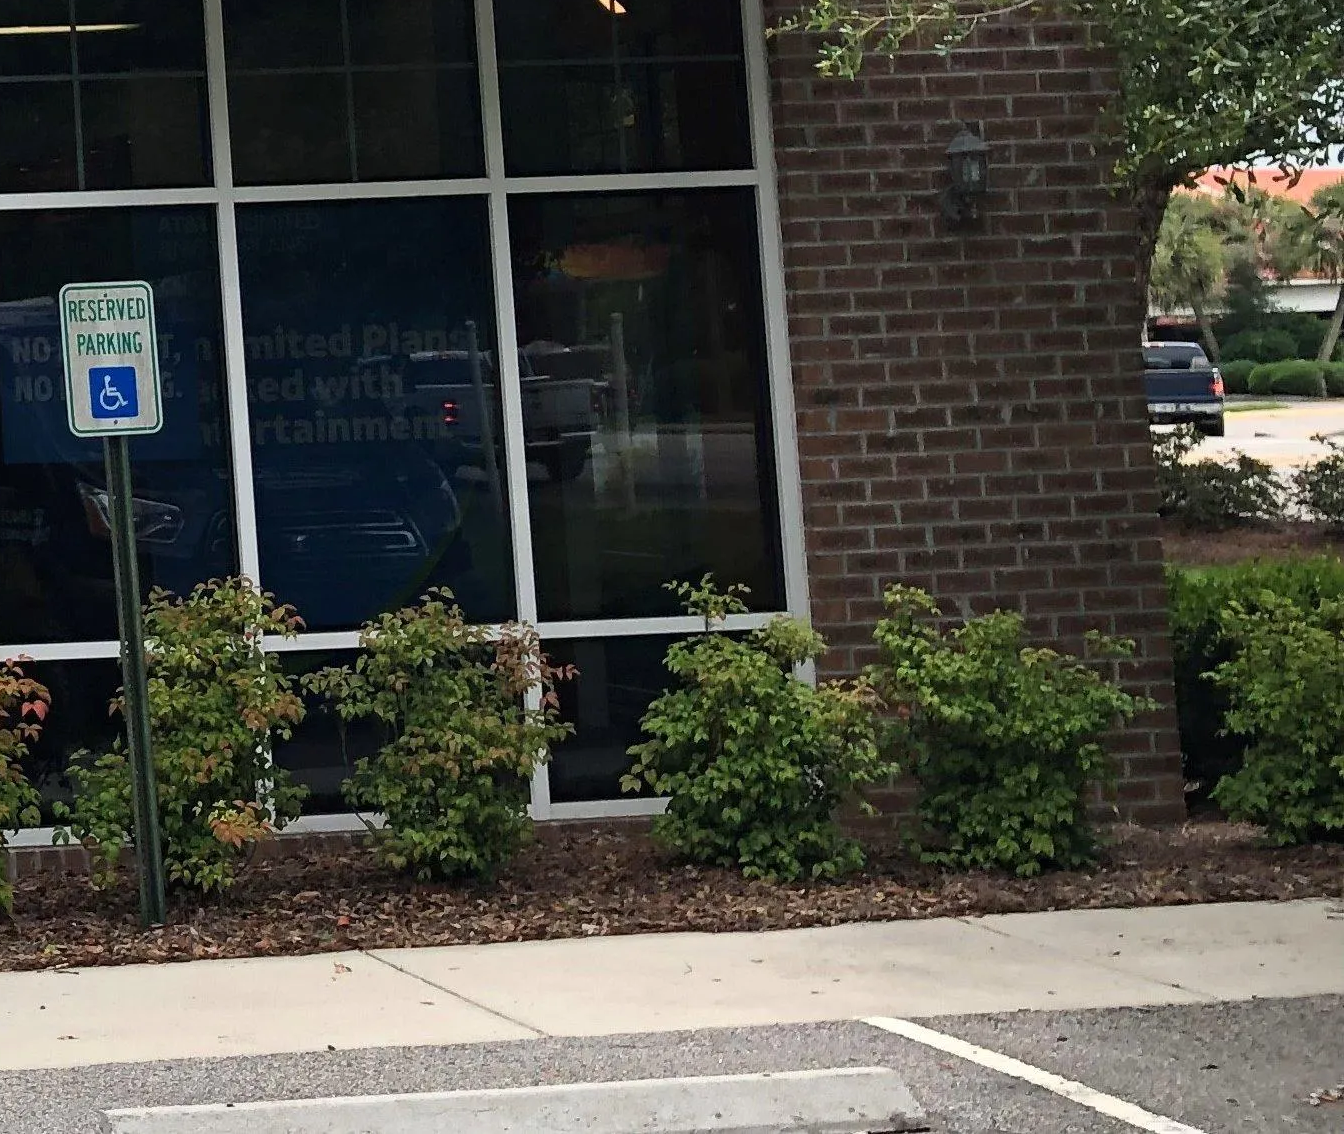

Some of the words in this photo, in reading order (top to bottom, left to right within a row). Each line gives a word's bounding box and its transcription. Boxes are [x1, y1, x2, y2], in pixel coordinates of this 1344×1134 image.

[68, 297, 146, 322] RESERVED
[76, 332, 143, 356] PARKING
[14, 375, 54, 403] NO
[314, 366, 404, 401] with
